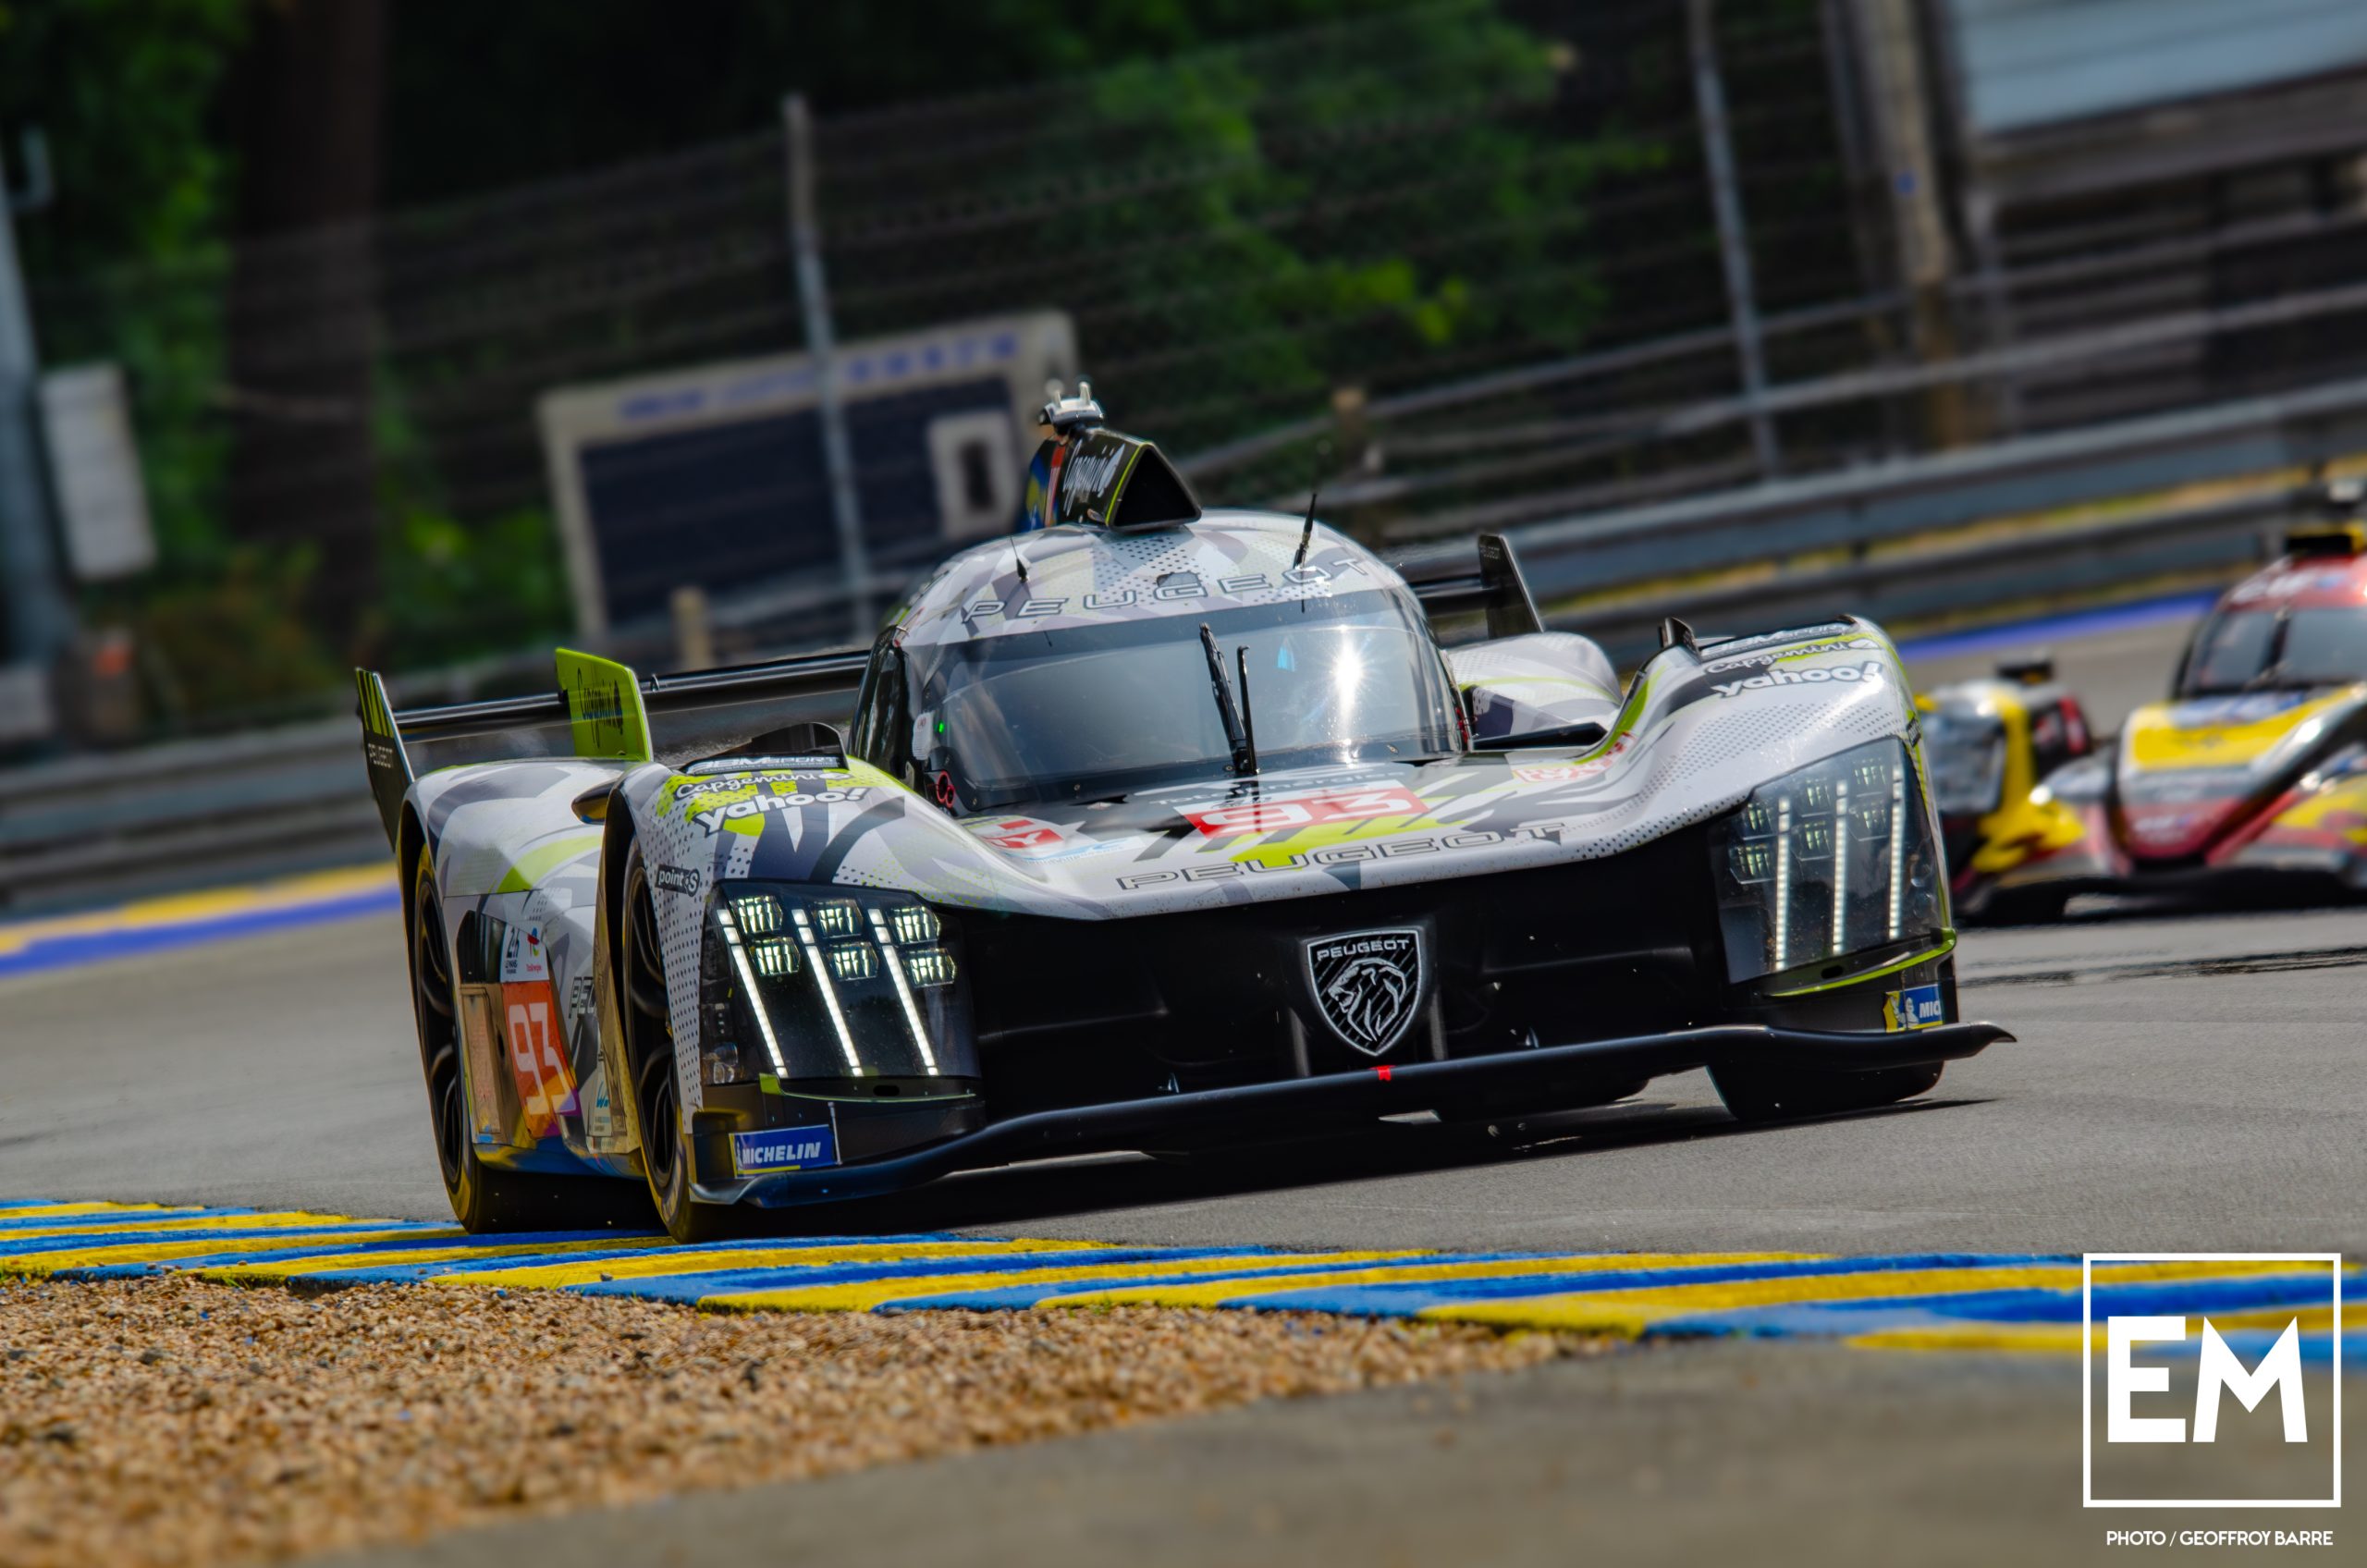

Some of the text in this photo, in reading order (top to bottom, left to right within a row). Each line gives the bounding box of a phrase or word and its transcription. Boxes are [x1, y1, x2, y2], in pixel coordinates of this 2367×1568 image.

[962, 557, 1368, 624] PEUGEOT
[1709, 640, 1848, 674] Capgemini
[1711, 662, 1883, 698] yahoo!
[675, 771, 819, 800] Capgemini
[693, 787, 868, 835] yahoo!
[1201, 791, 1413, 833] 93
[1115, 822, 1566, 890] PEUGEOT
[657, 869, 684, 887] point
[1317, 939, 1410, 962] PEUGEOT
[509, 1001, 577, 1116] 93
[742, 1142, 821, 1165] MICHELIN
